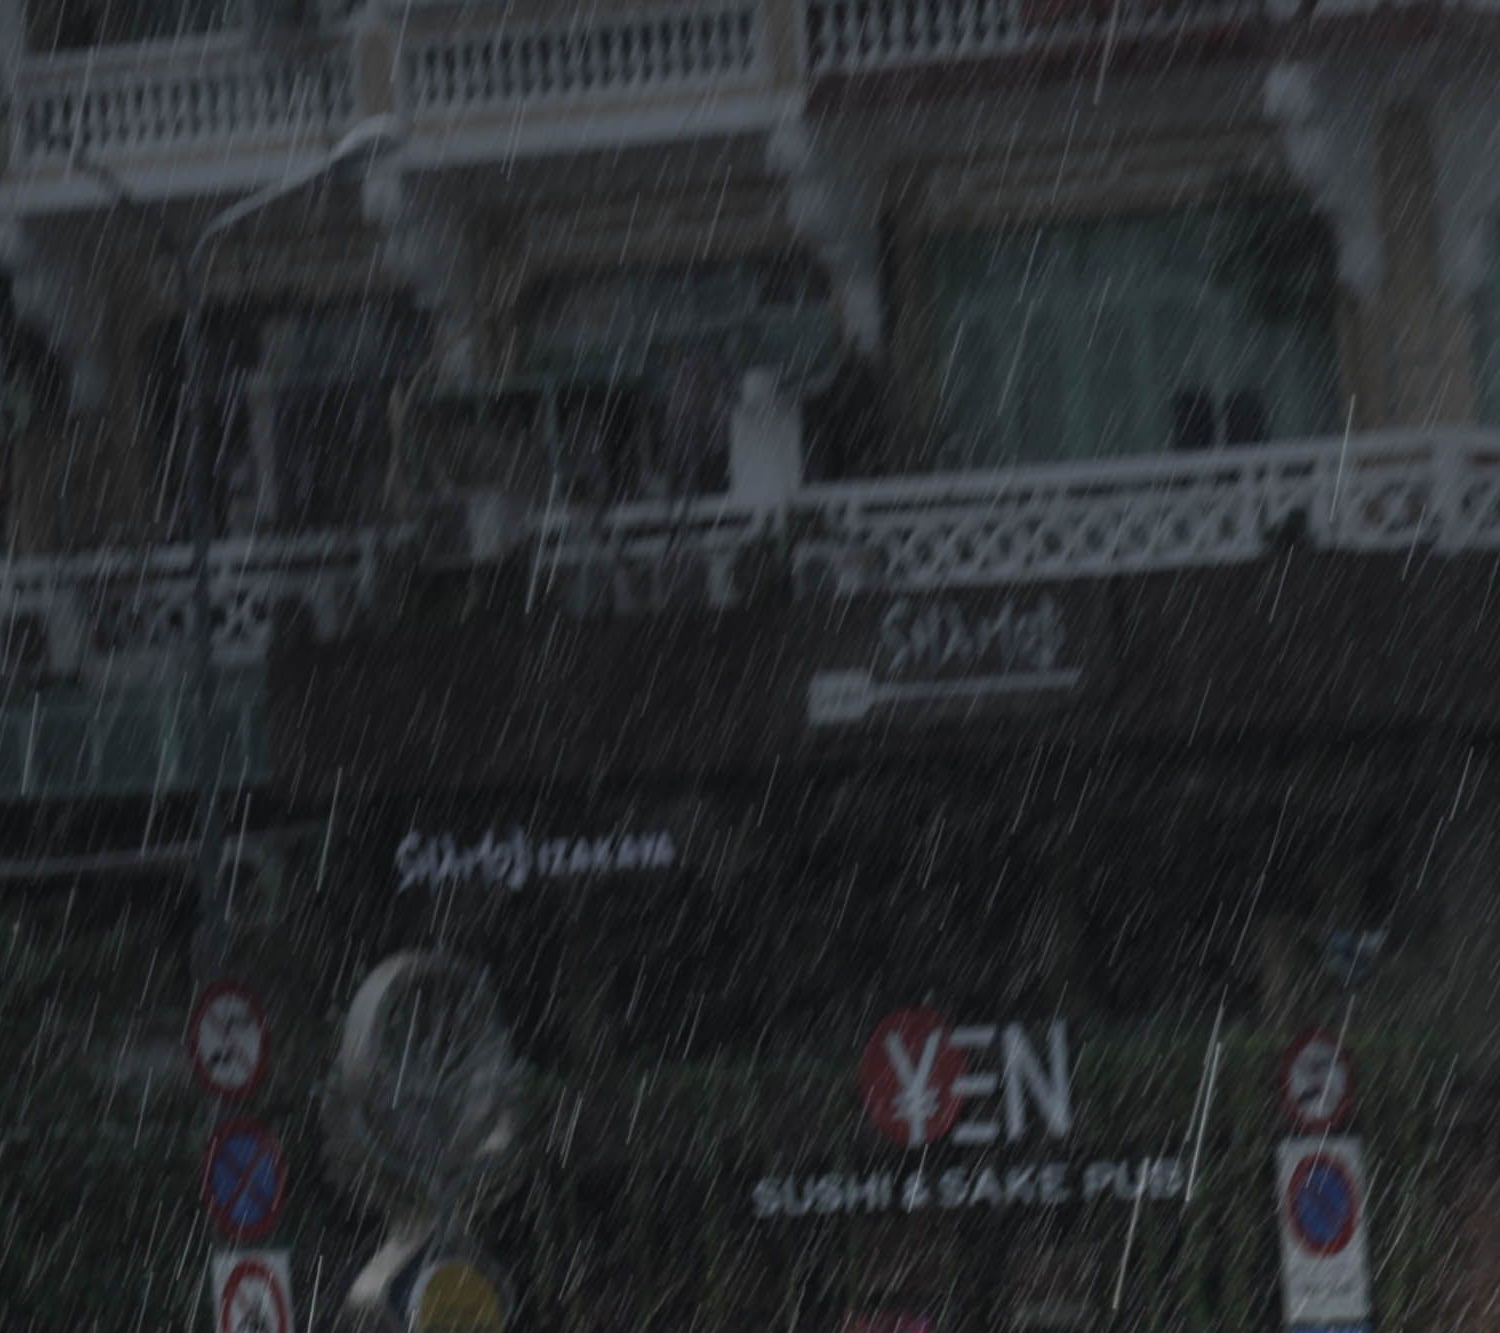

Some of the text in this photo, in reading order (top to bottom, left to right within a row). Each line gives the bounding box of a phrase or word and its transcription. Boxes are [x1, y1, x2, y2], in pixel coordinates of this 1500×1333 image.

[750, 1155, 1189, 1219] SUSHI & SAKE PUB
